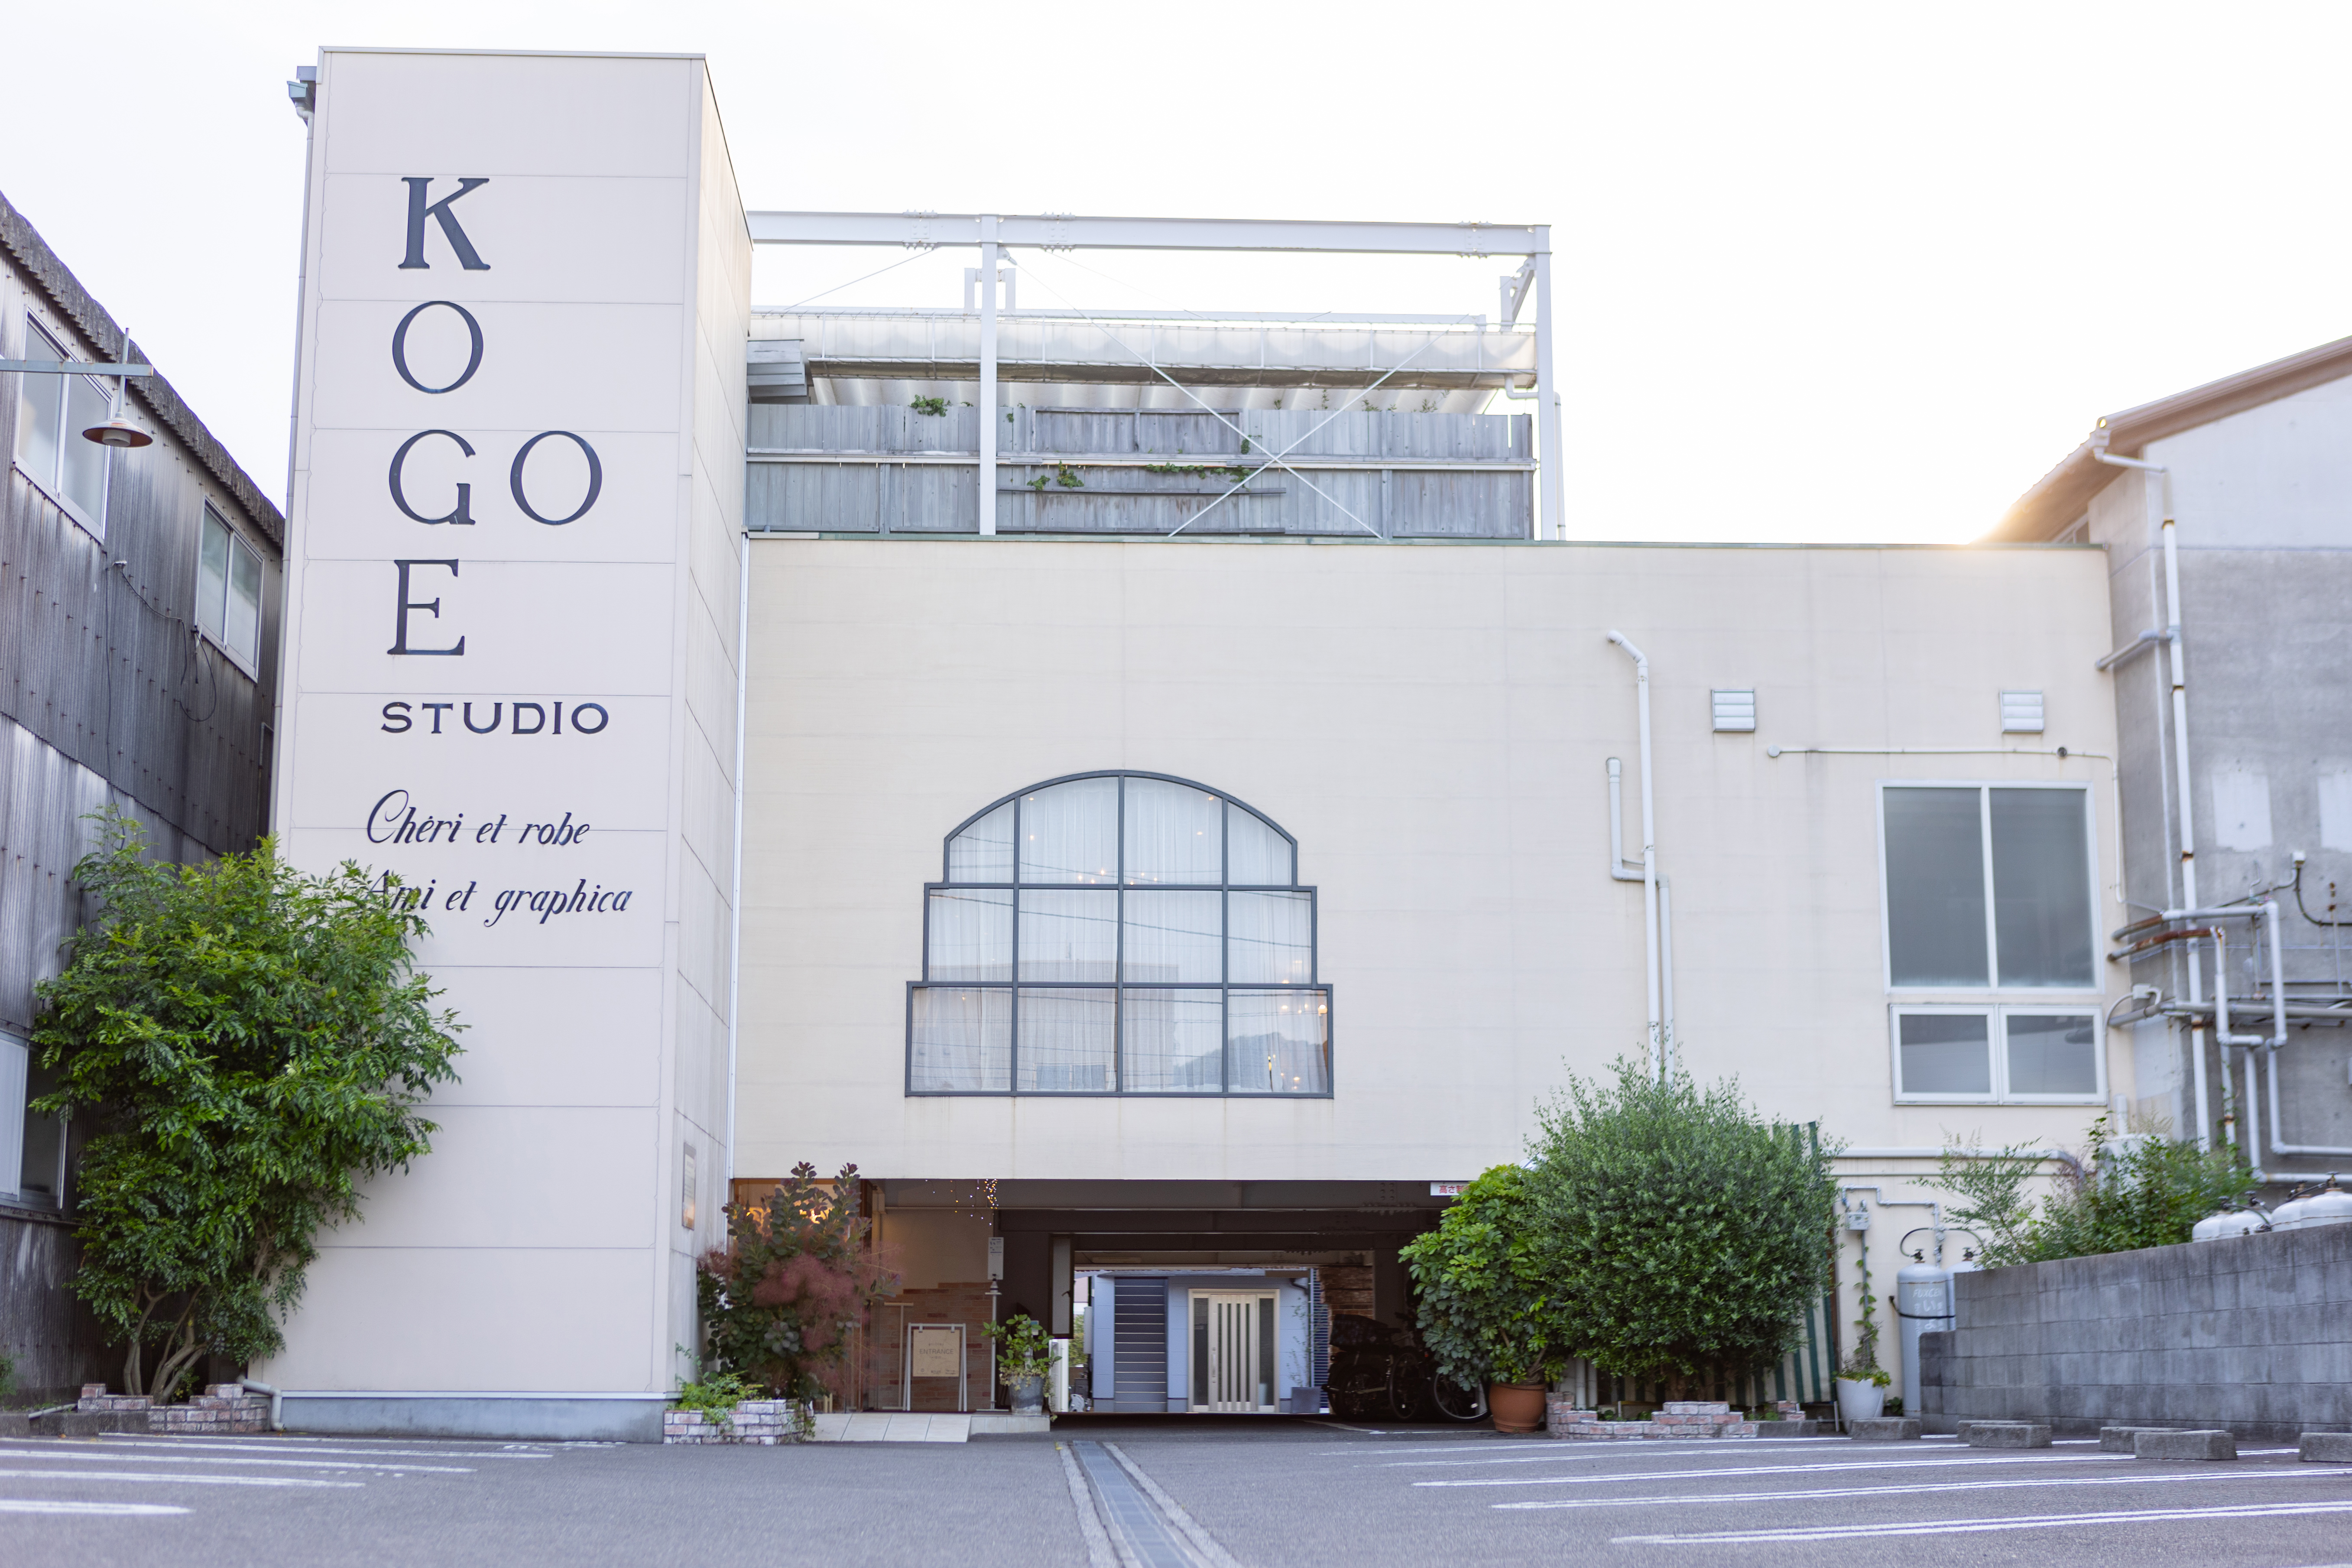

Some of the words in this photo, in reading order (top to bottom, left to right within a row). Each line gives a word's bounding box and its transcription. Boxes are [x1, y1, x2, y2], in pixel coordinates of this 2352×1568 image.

[381, 701, 609, 735] STUDIO
[476, 814, 507, 844] et
[518, 812, 590, 846] robe
[445, 881, 478, 911] et
[484, 879, 633, 928] graphica
